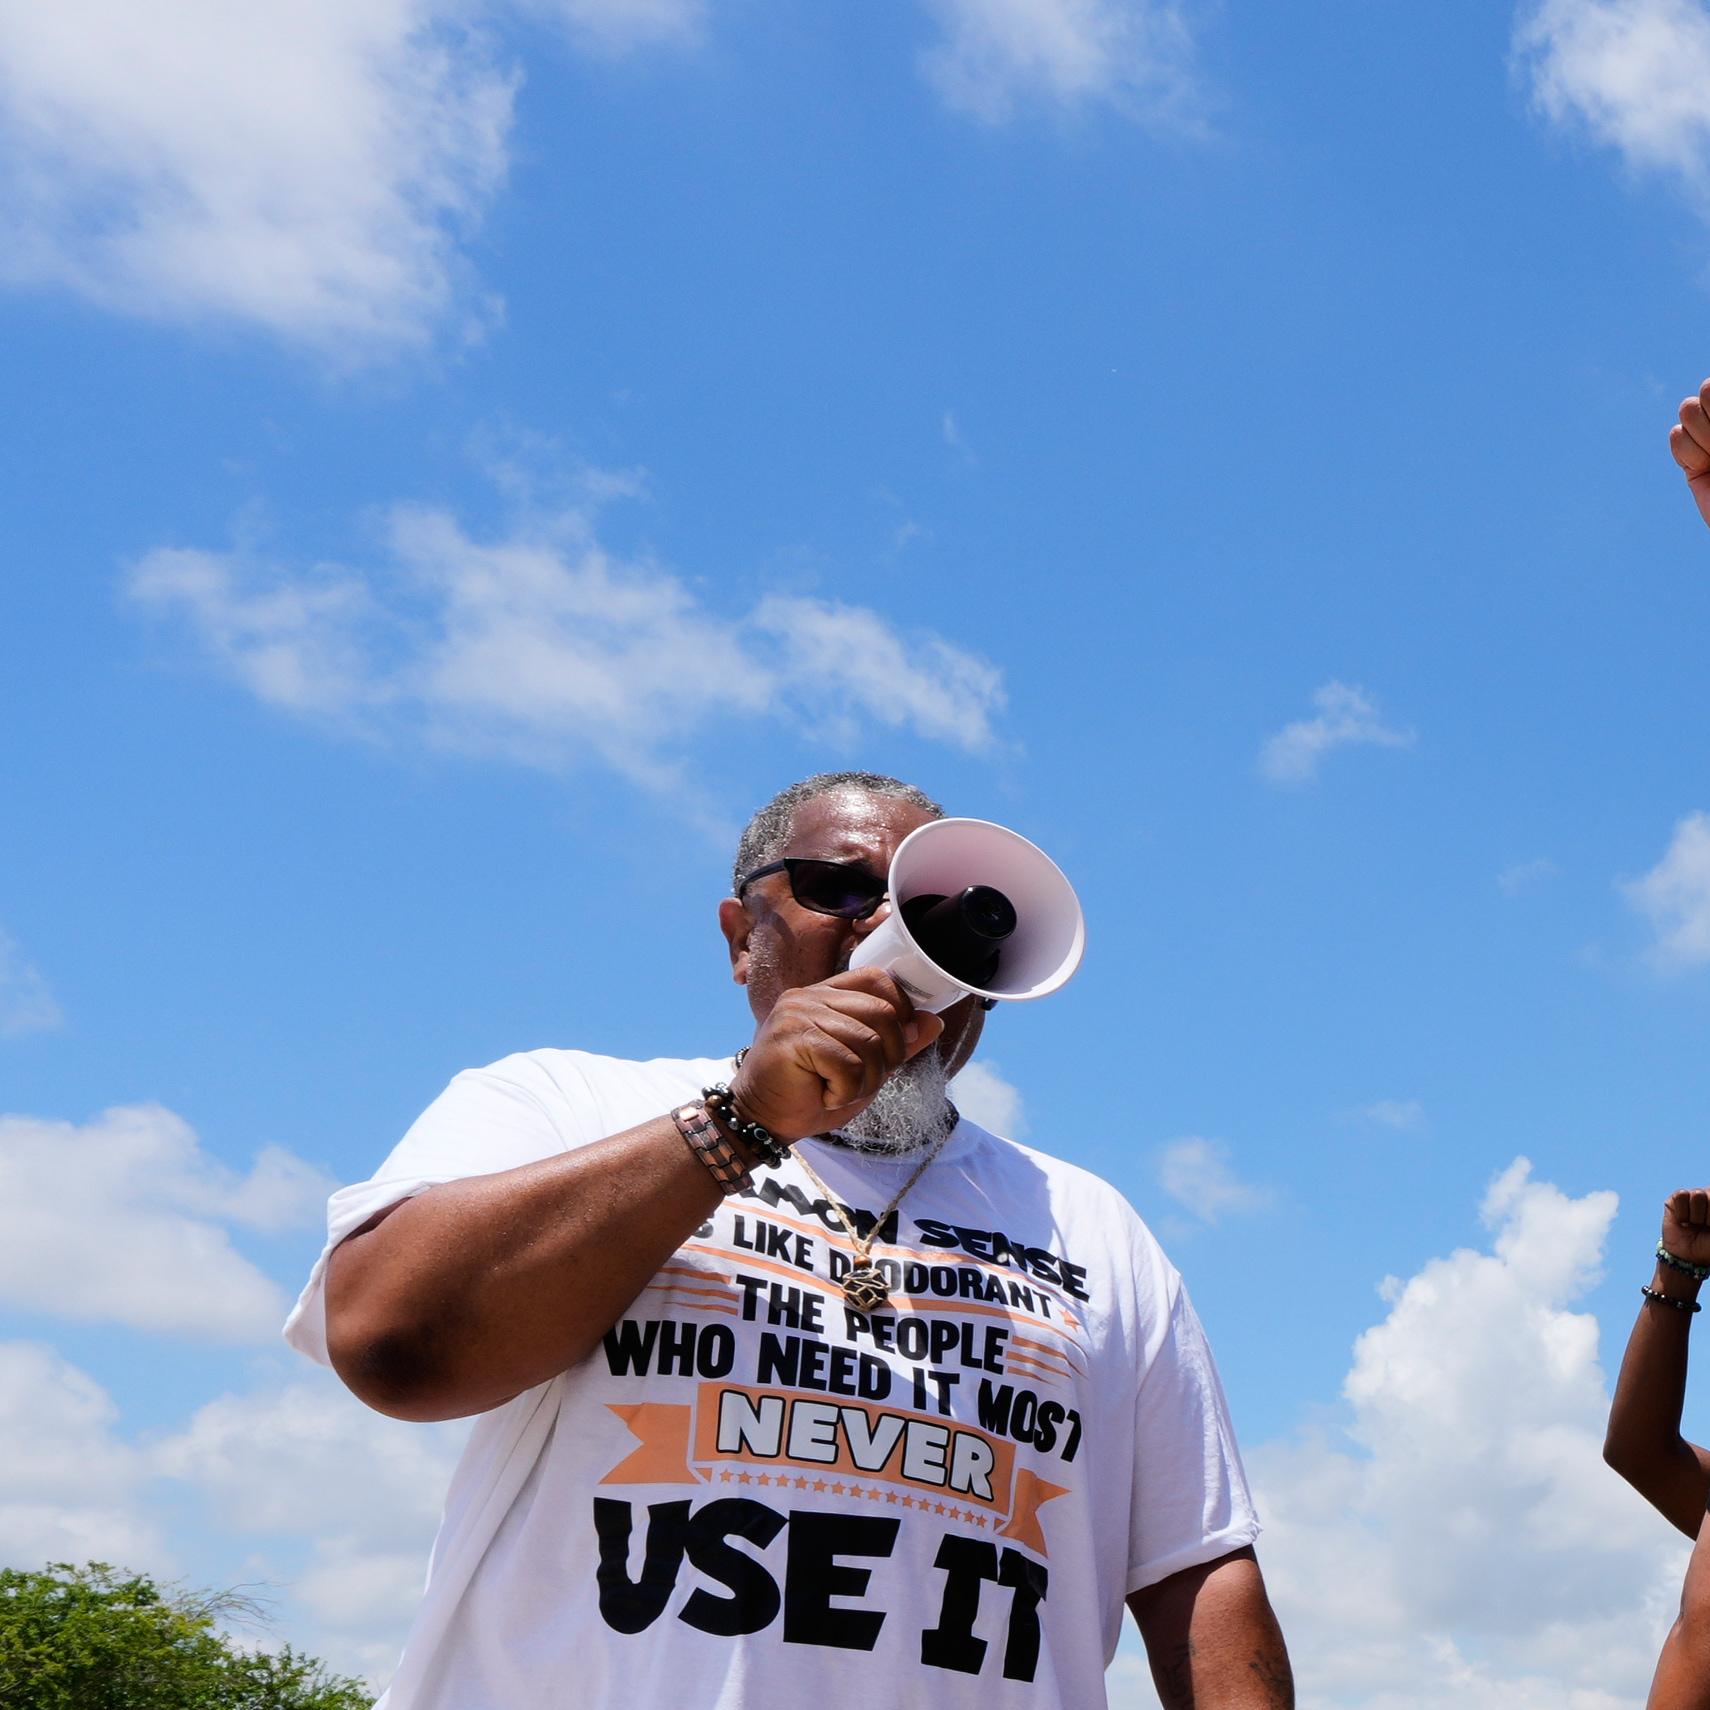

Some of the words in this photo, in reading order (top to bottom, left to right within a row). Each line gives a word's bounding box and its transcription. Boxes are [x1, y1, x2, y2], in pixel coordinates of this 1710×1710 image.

[733, 1213, 815, 1272] LIKE
[829, 1248, 1052, 1318] DODORANT
[914, 1218, 1089, 1303] SENSE
[736, 1273, 825, 1333] THE
[845, 1306, 1010, 1374] PEOPLE
[603, 1318, 735, 1379] WHO
[757, 1332, 892, 1400] NEED
[913, 1369, 961, 1415] IT
[977, 1377, 1083, 1463] MOST
[714, 1388, 996, 1503] NEVER
[593, 1495, 901, 1652] USE
[920, 1532, 1050, 1683] IT
